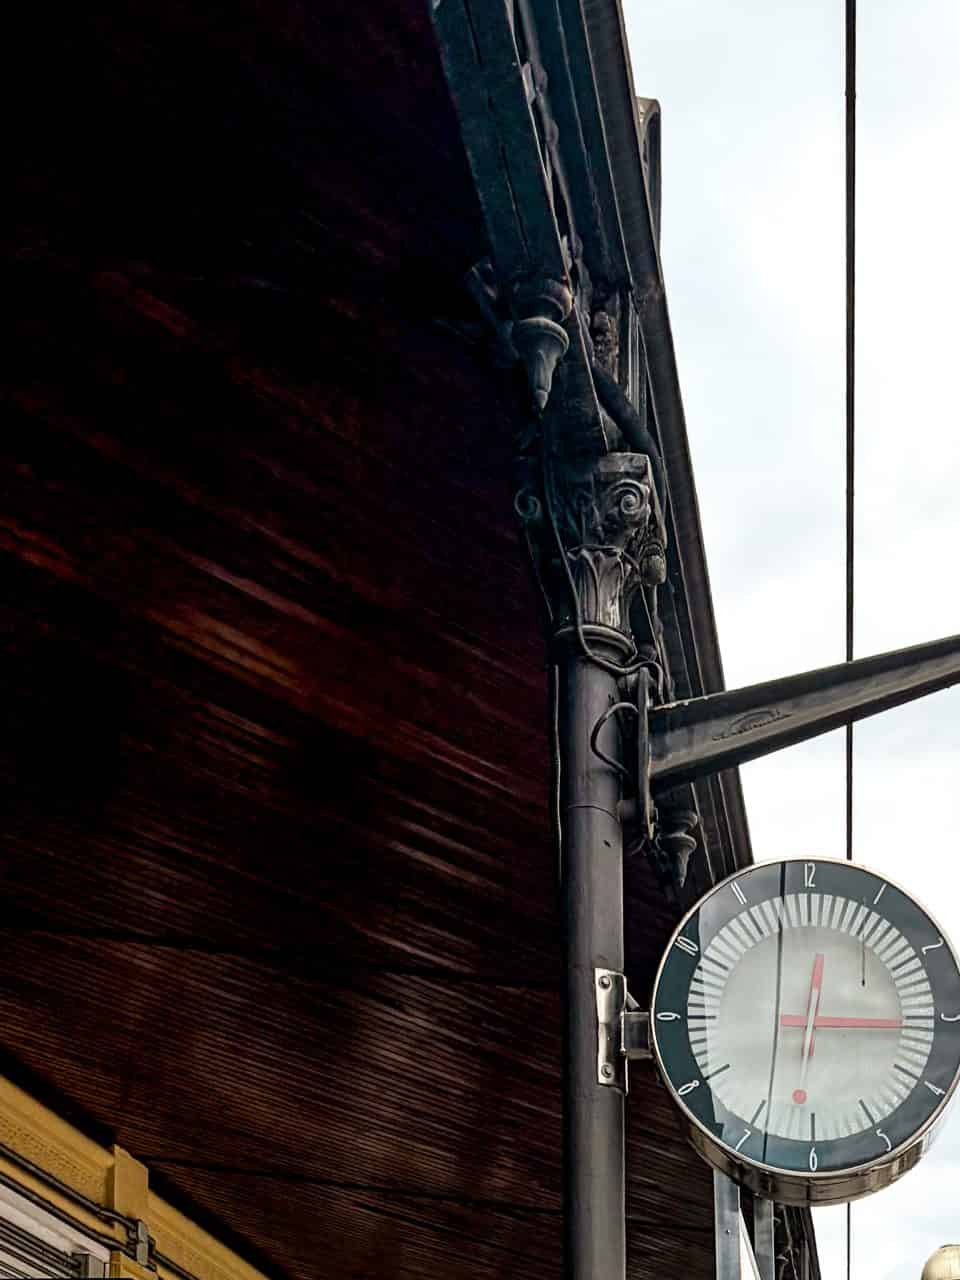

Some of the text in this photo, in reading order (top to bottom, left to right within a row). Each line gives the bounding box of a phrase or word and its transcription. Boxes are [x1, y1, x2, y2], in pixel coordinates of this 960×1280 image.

[803, 863, 816, 888] 12
[730, 881, 748, 905] 11
[873, 883, 888, 905] 1
[675, 935, 700, 957] 10
[921, 937, 945, 956] 2
[656, 1012, 681, 1022] 9
[678, 1080, 701, 1097] 8
[924, 1081, 946, 1097] 4
[735, 1129, 751, 1152] 7
[877, 1129, 893, 1151] 5
[808, 1147, 818, 1172] 6
